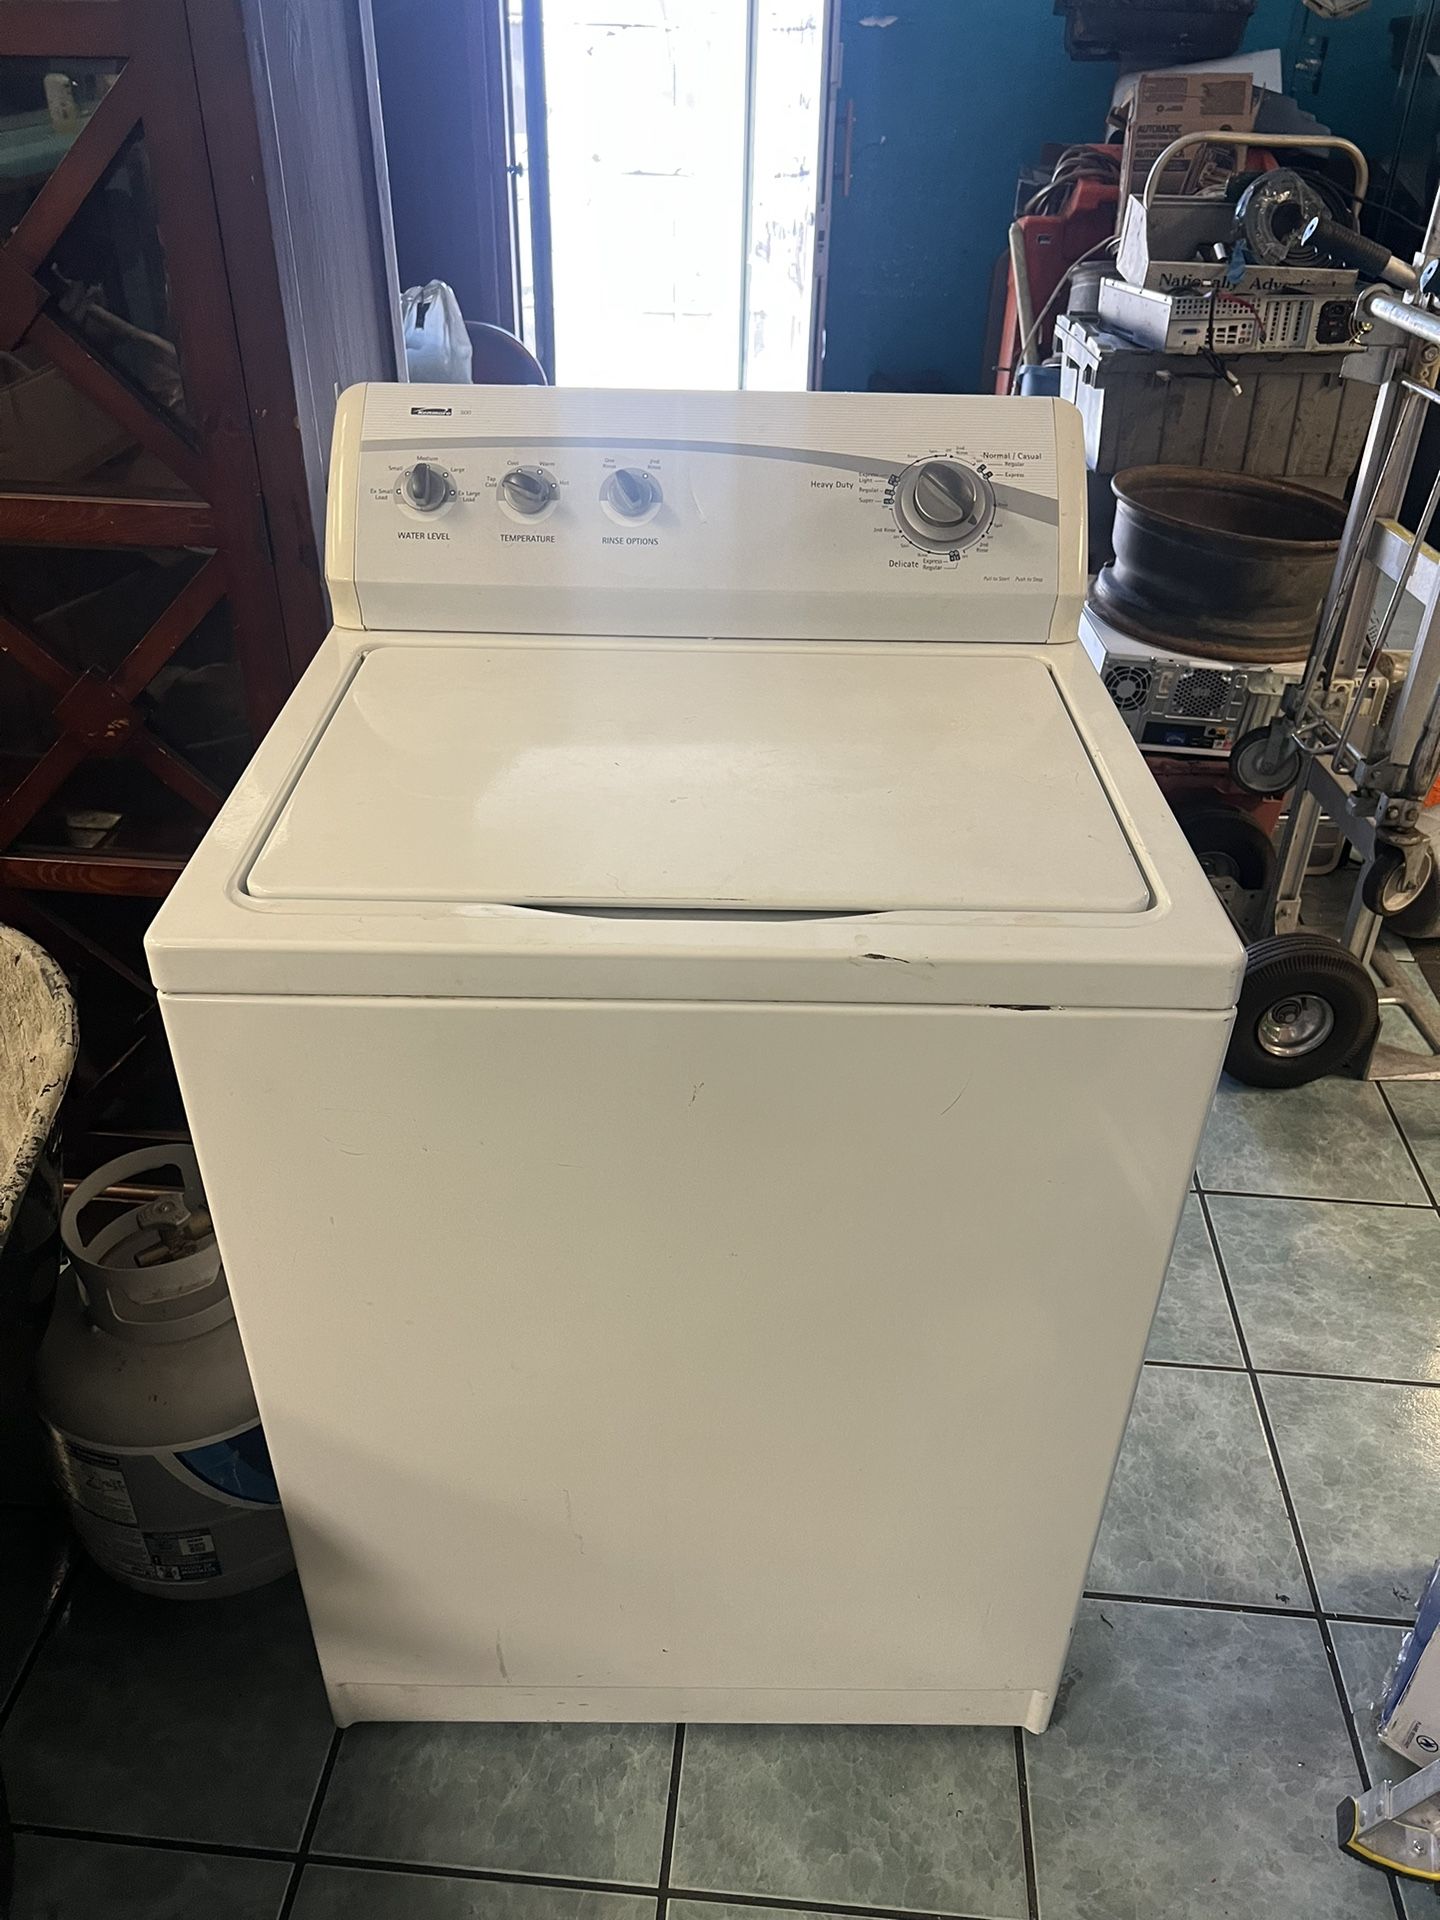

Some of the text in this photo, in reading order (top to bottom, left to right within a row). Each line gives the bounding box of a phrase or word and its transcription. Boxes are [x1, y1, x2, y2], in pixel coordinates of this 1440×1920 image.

[1159, 273, 1238, 291] Natioally
[983, 452, 1010, 460] Normal
[1018, 452, 1042, 460] Casual
[811, 481, 854, 489] Heavy Duty
[398, 532, 450, 541] WATER LEVEL
[500, 534, 556, 543] TEMPERATURE
[602, 537, 659, 546] RINSE OPTIONS
[889, 560, 919, 568] Delicate
